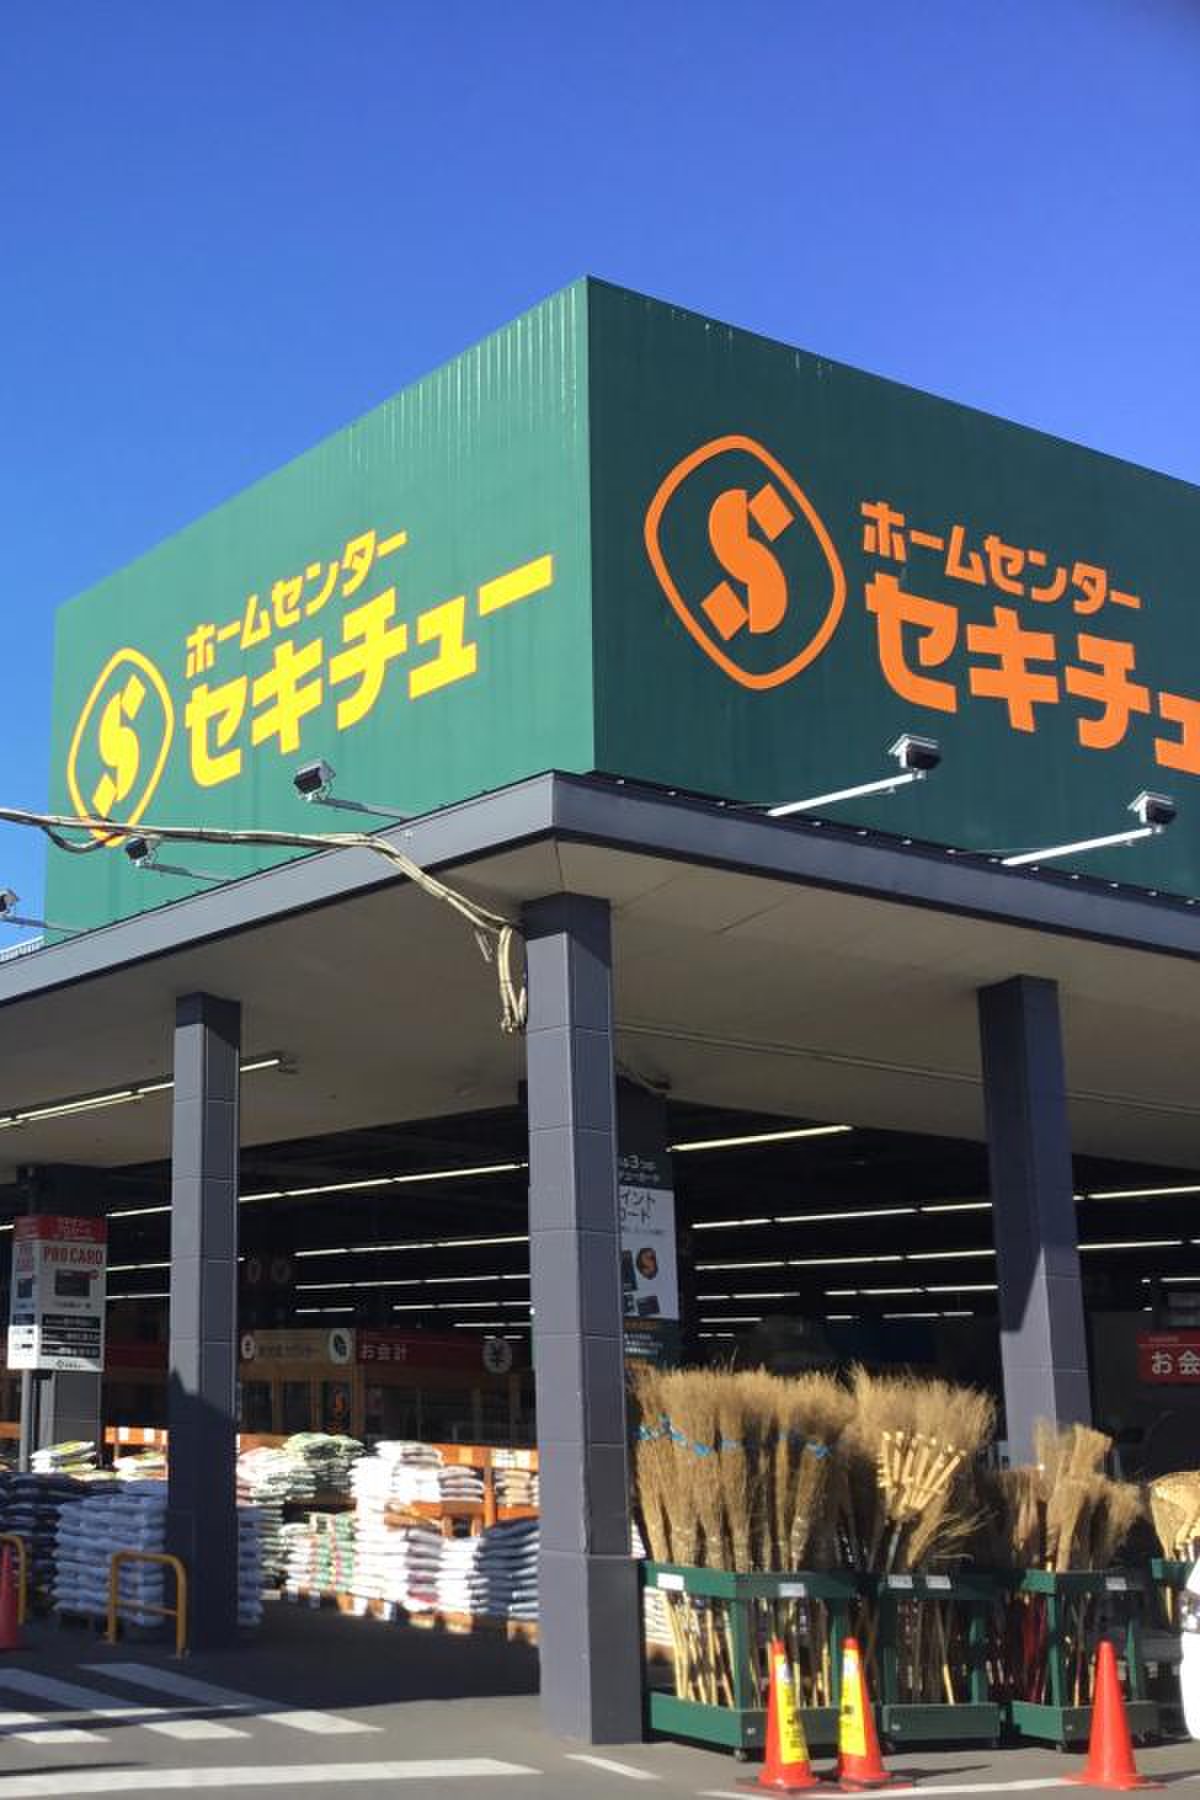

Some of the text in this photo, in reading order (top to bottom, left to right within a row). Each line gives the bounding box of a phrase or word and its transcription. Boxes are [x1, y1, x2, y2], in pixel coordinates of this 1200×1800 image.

[184, 529, 408, 679] ホームセンター
[860, 501, 1142, 615] ホームセンター
[185, 554, 554, 788] セキチュー
[70, 1247, 104, 1266] CARD
